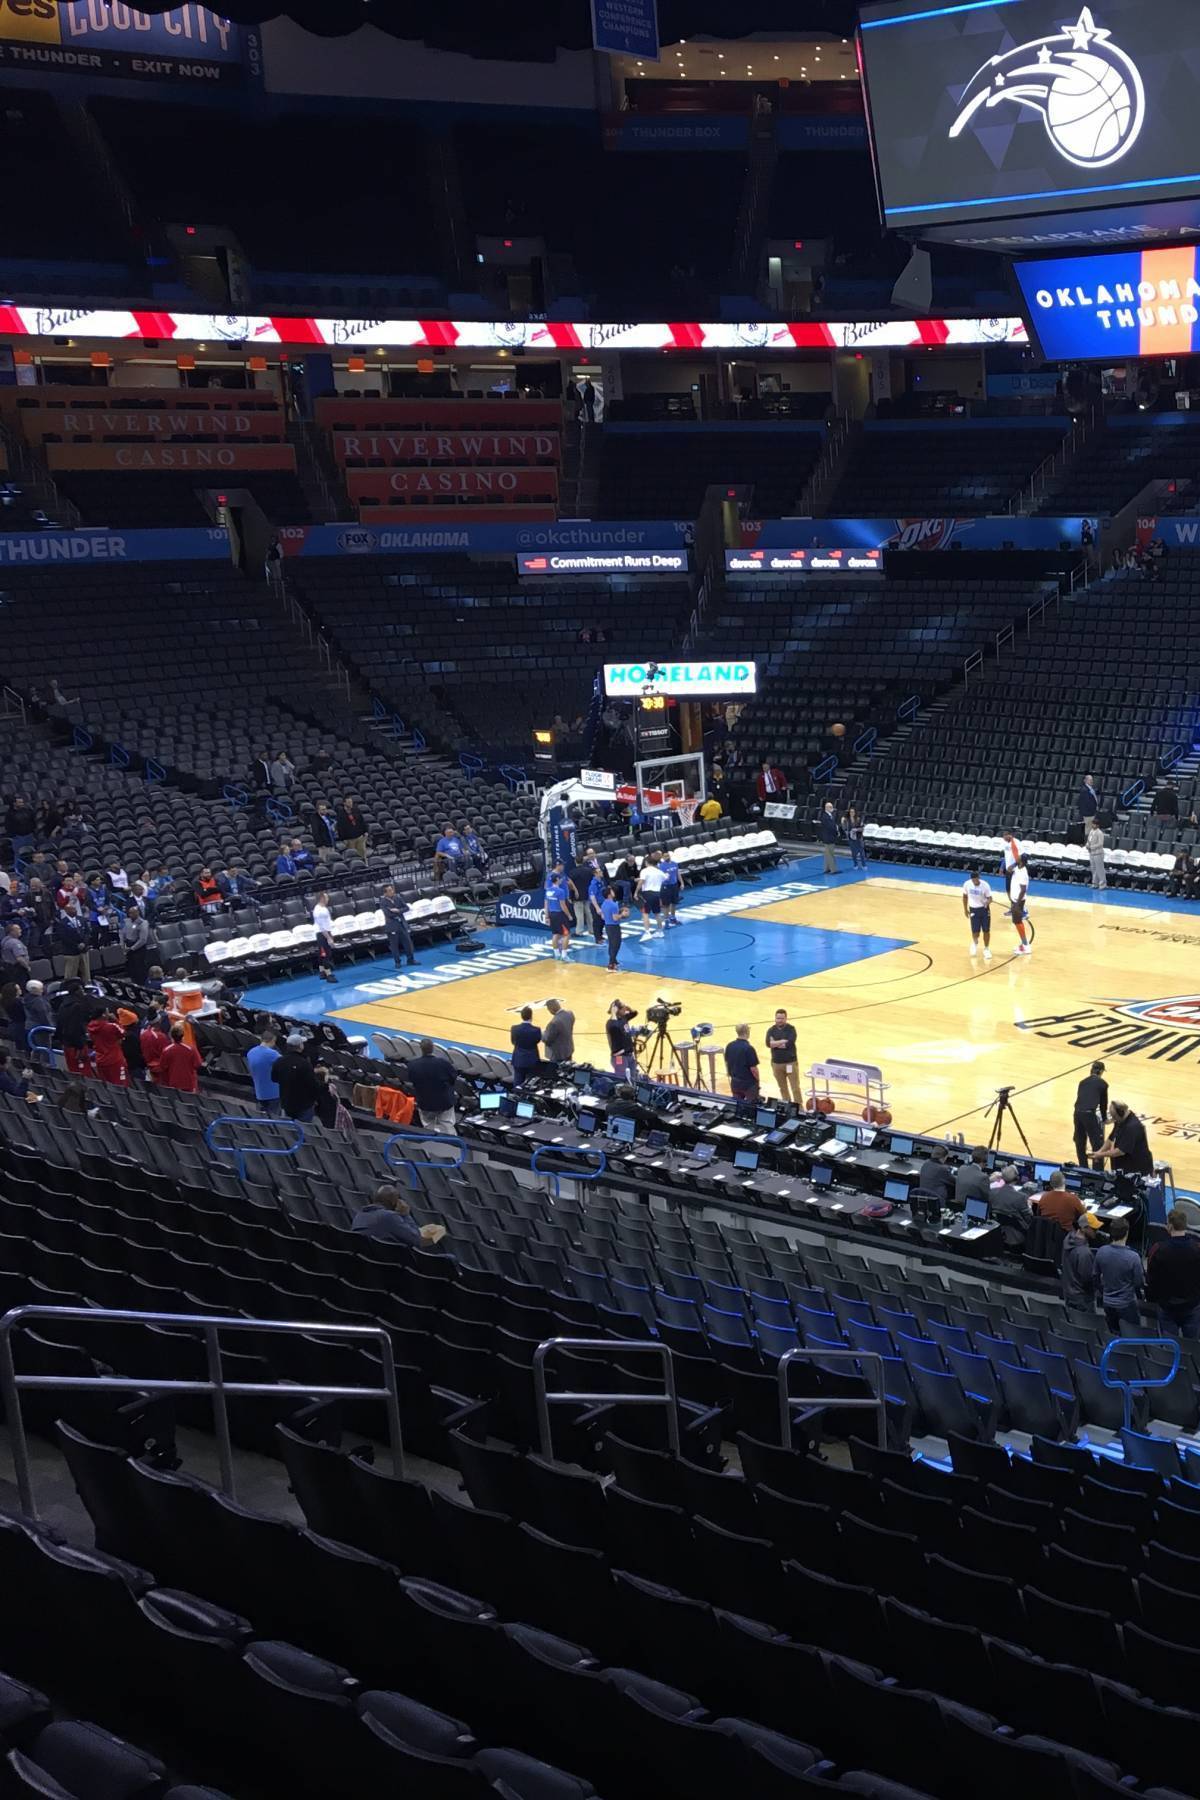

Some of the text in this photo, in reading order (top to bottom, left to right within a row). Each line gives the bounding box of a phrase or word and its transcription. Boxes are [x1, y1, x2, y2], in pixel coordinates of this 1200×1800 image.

[11, 46, 221, 80] THUNDER EXIT NOW
[63, 413, 253, 433] RIVERWIND
[343, 436, 554, 458] RIVERWIND
[115, 447, 236, 467] CASINO
[390, 471, 518, 491] CASINO
[740, 522, 762, 534] 103
[1137, 518, 1156, 530] 104
[207, 529, 229, 541] 101
[280, 528, 305, 540] 102
[345, 532, 470, 548] FOX OKLAHOMA
[516, 530, 645, 549] @okcthunder
[550, 554, 682, 572] Commitment Runs Deep
[500, 902, 547, 925] SPALDING
